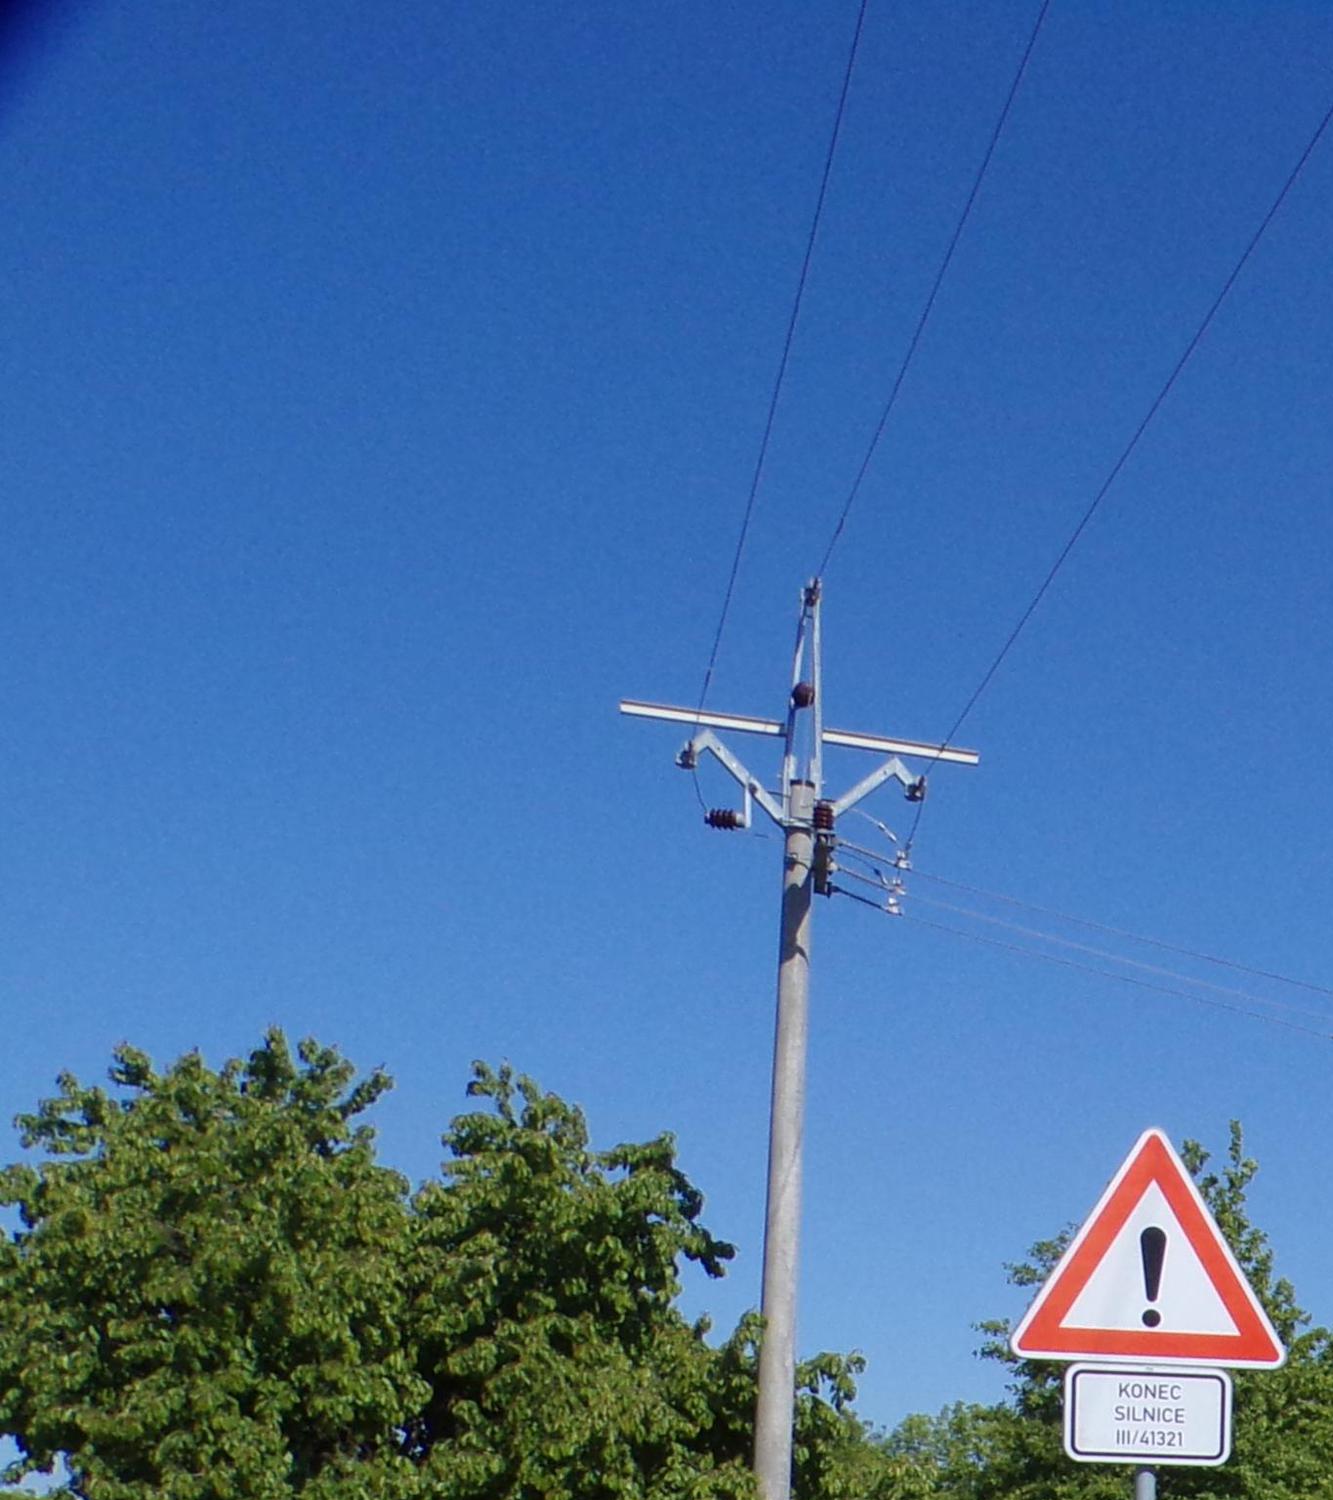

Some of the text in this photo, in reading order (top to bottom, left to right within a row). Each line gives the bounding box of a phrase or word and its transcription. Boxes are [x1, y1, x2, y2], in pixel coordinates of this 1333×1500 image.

[1118, 1382, 1183, 1401] KONEC
[1114, 1405, 1186, 1424] SILNICE
[1116, 1429, 1184, 1447] III/41321
